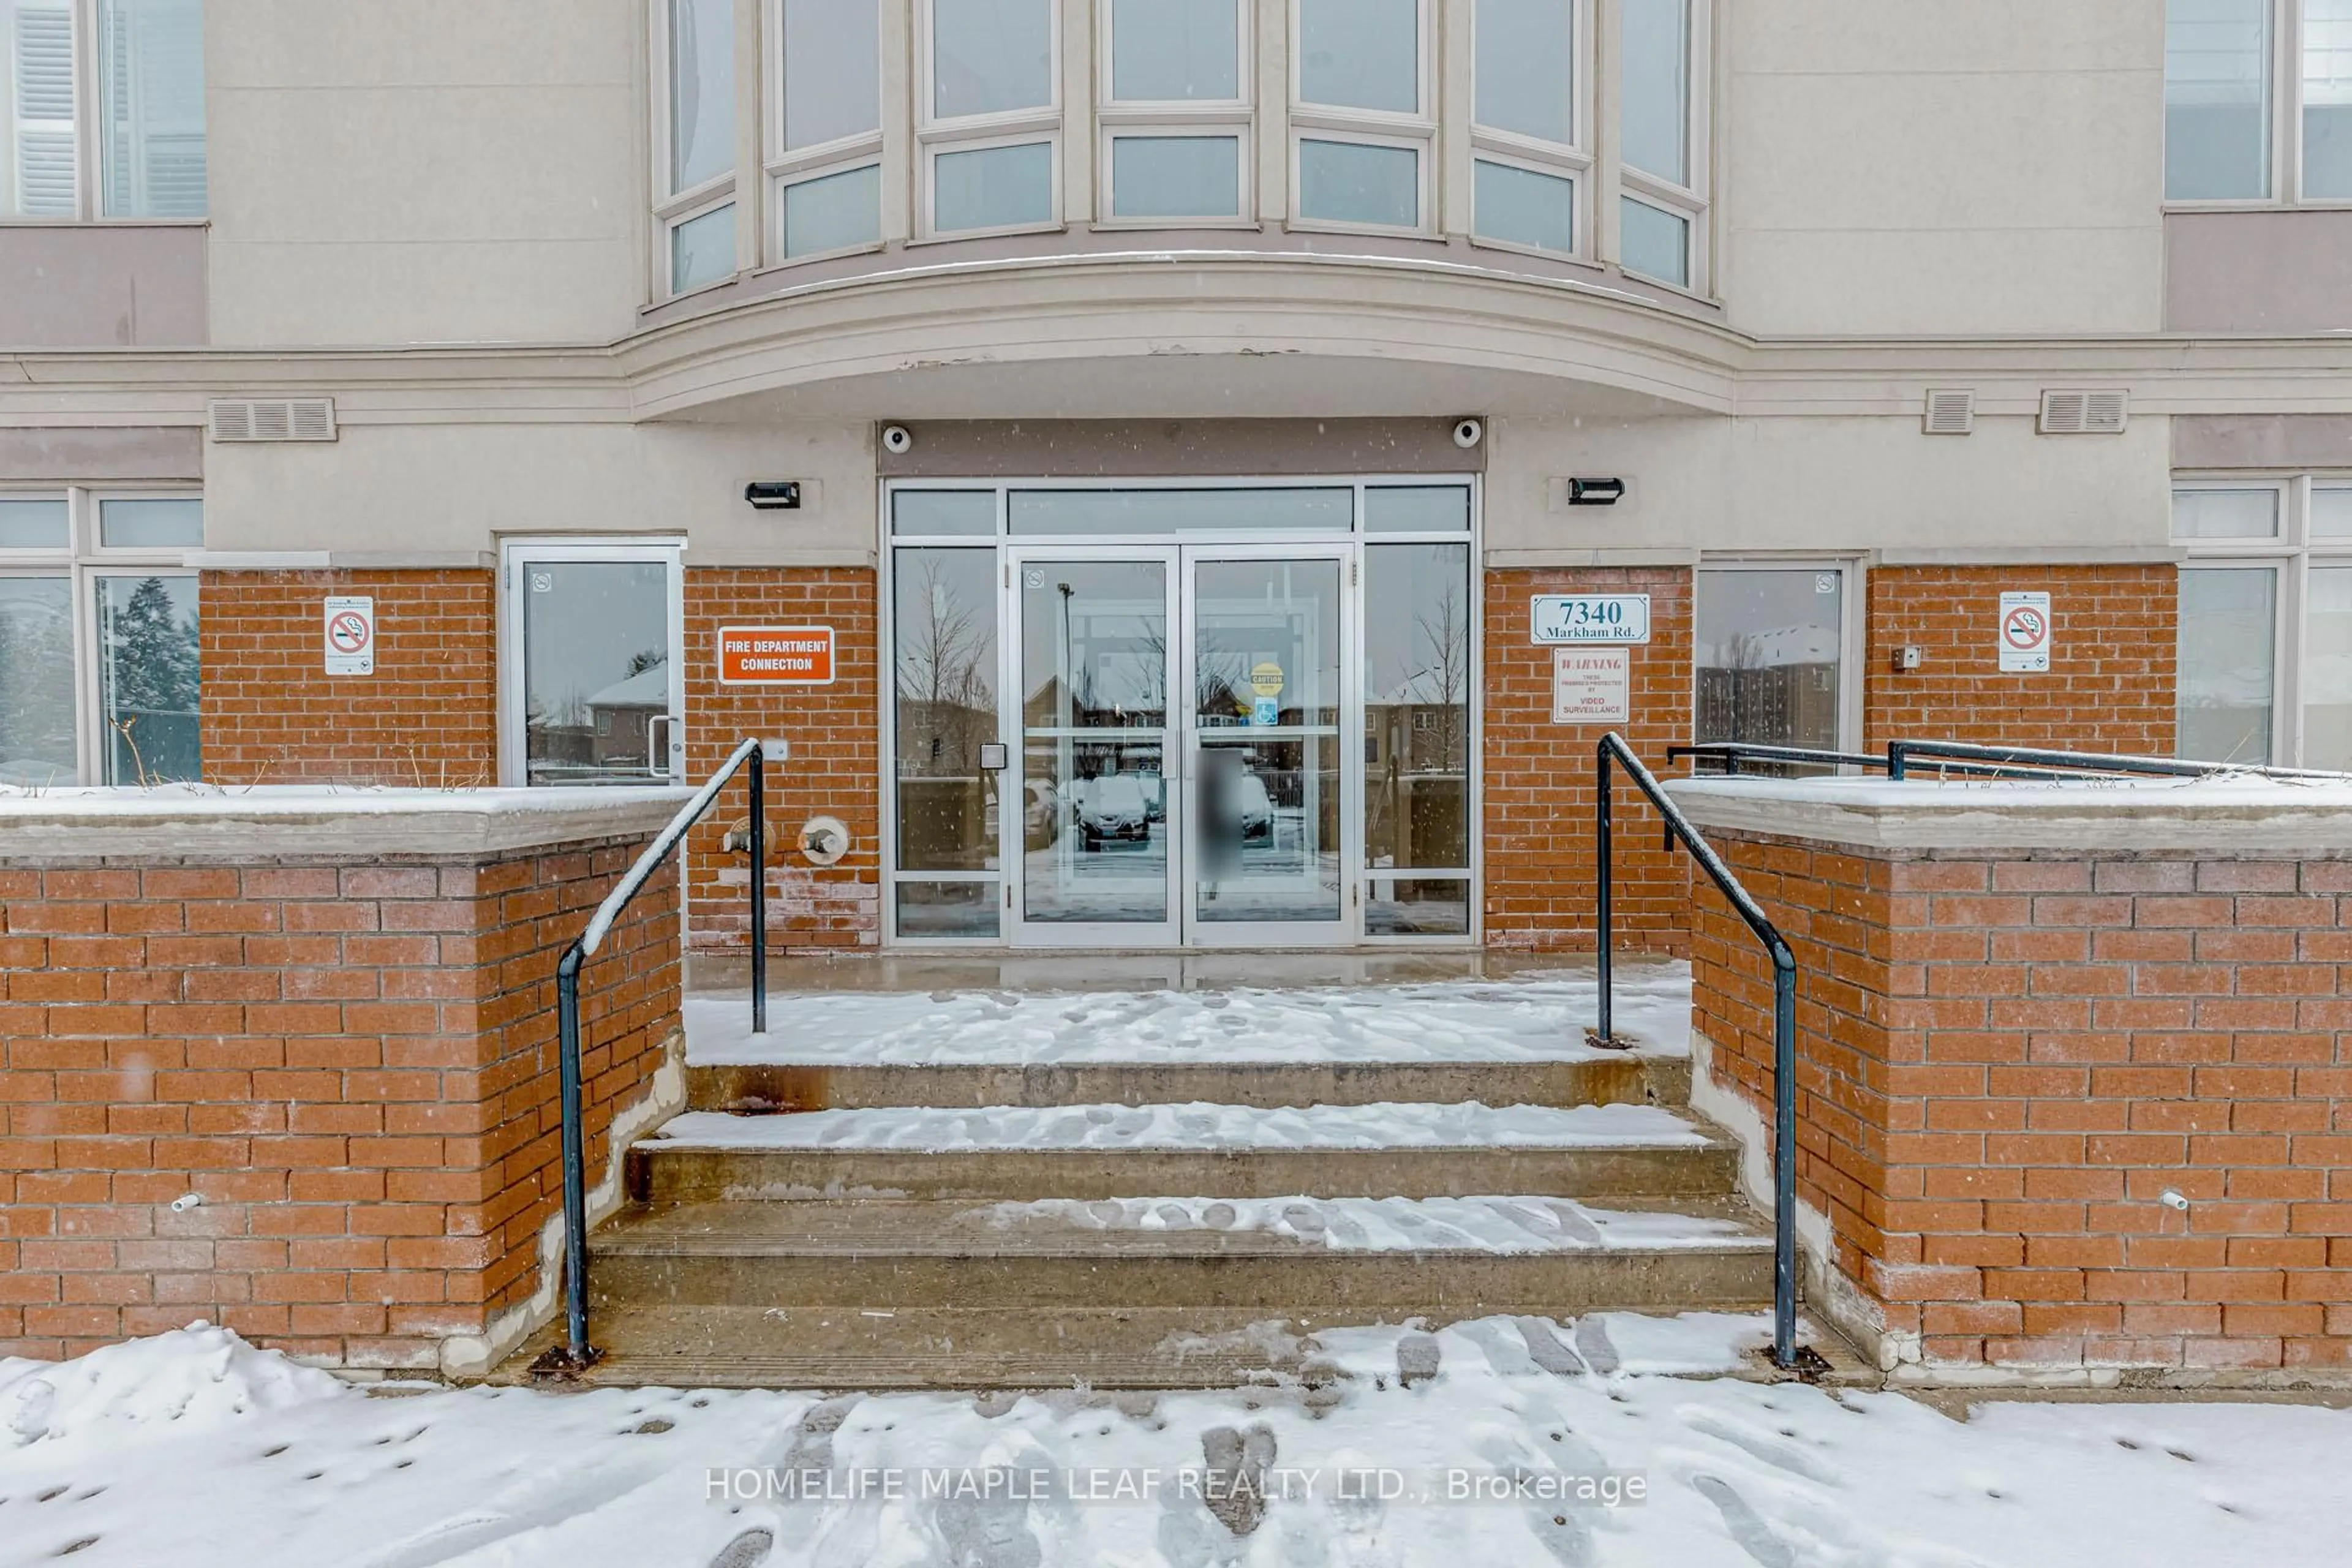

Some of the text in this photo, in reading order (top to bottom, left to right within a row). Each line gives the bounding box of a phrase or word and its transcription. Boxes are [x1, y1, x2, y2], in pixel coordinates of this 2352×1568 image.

[1560, 601, 1622, 625] 7340
[1546, 627, 1635, 638] Markham Rd.
[725, 641, 827, 653] FIRE DEPARTMENT
[741, 658, 813, 671] CONNECTION
[1561, 658, 1621, 669] WARNING
